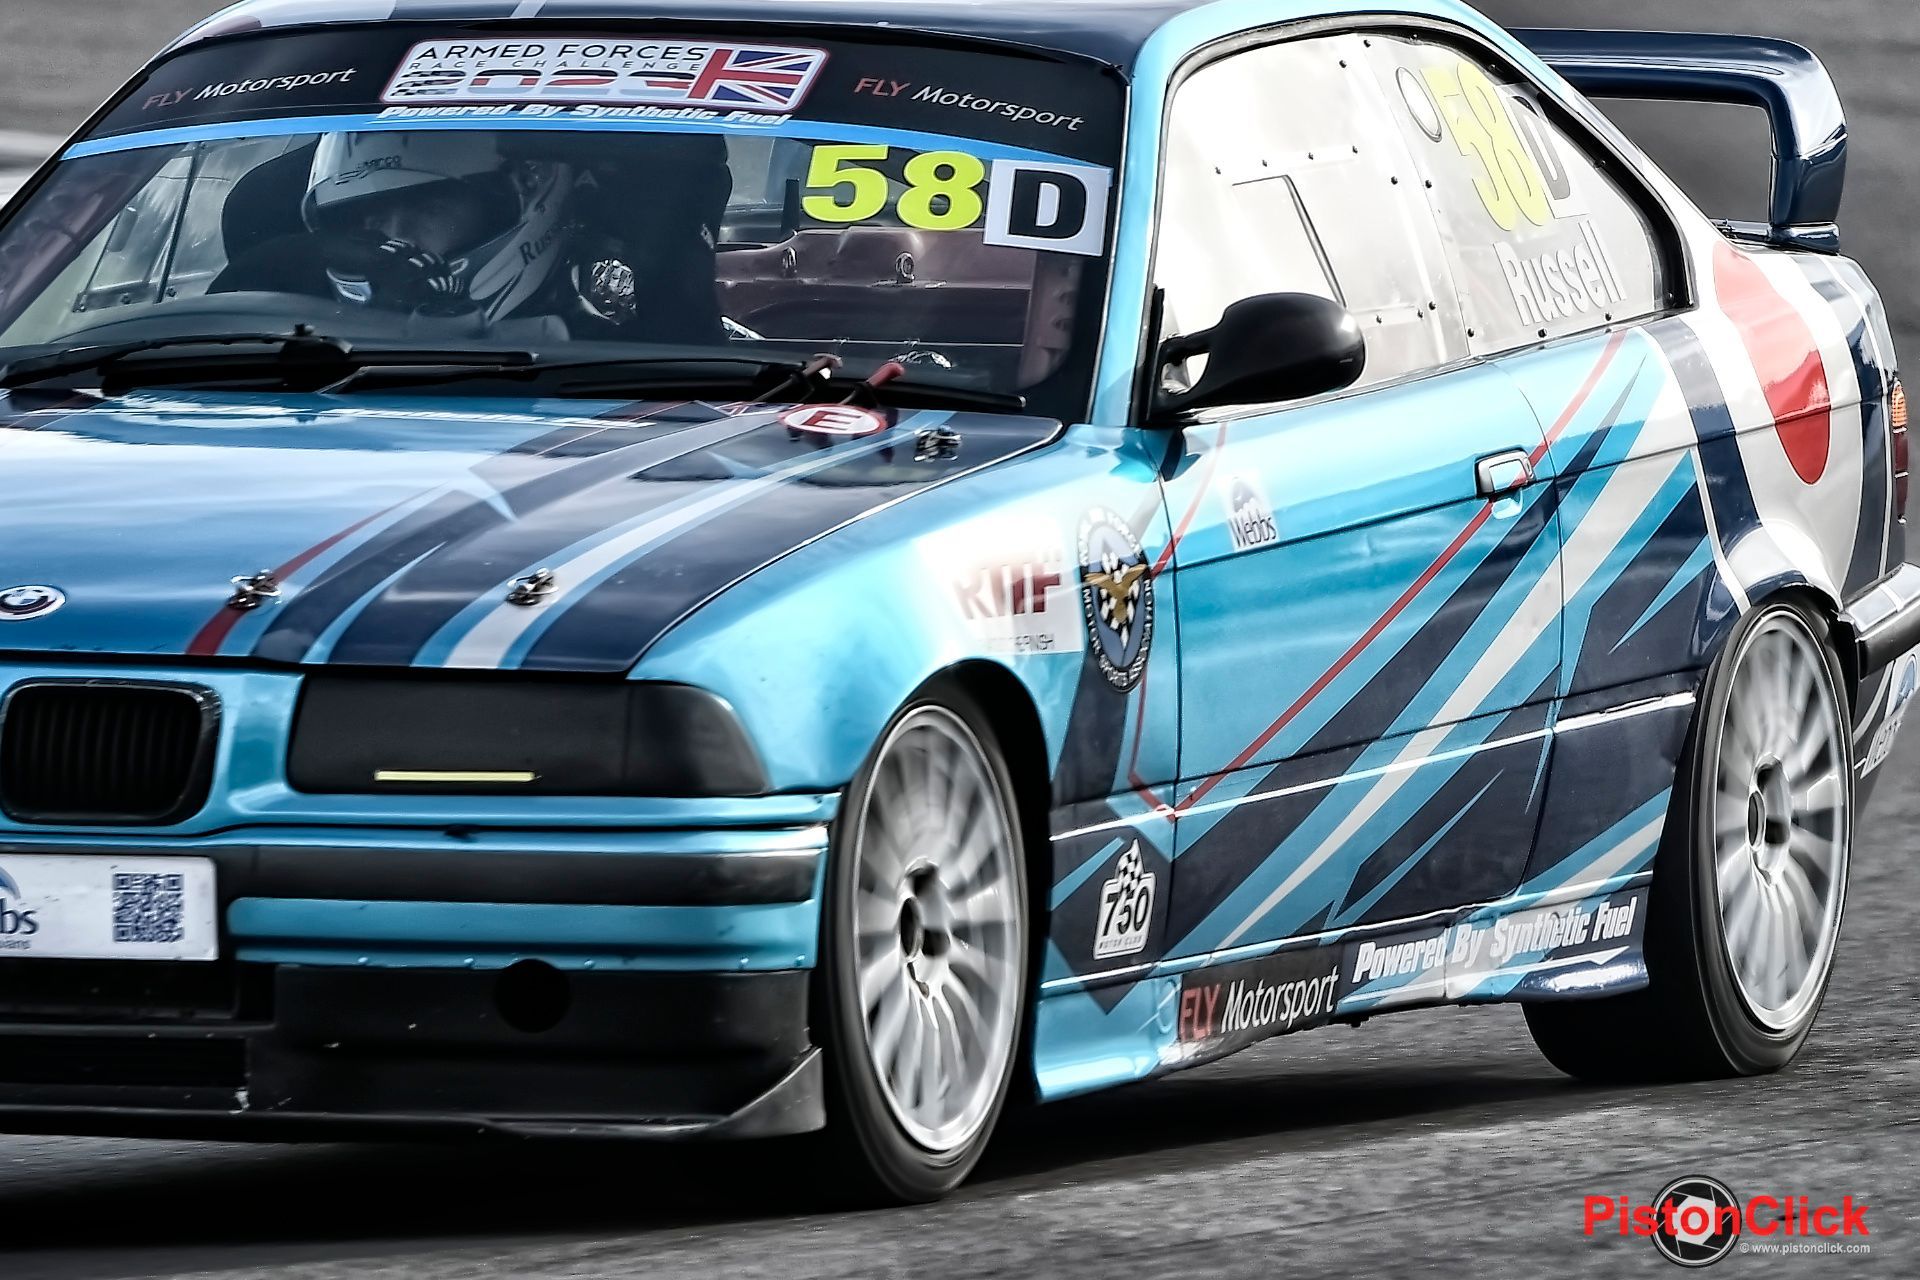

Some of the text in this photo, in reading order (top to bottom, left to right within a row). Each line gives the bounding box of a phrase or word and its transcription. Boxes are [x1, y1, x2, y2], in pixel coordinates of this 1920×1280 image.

[408, 60, 703, 71] RACE CHALLENGE
[415, 44, 710, 61] ARMED FORCES
[142, 67, 358, 110] FLY Motorsport
[854, 76, 1086, 131] FLY Motorsport
[375, 103, 794, 127] Powered By Synthetic Fuel
[1419, 61, 1547, 232] 58
[802, 143, 1087, 241] 58 D
[1492, 219, 1628, 327] Russell
[800, 410, 862, 431] E
[1228, 508, 1277, 548] Webbs
[1102, 886, 1149, 937] 750
[1352, 896, 1639, 984] Powered By Synthetic Fuel
[1180, 965, 1341, 1042] FLY Motorsport
